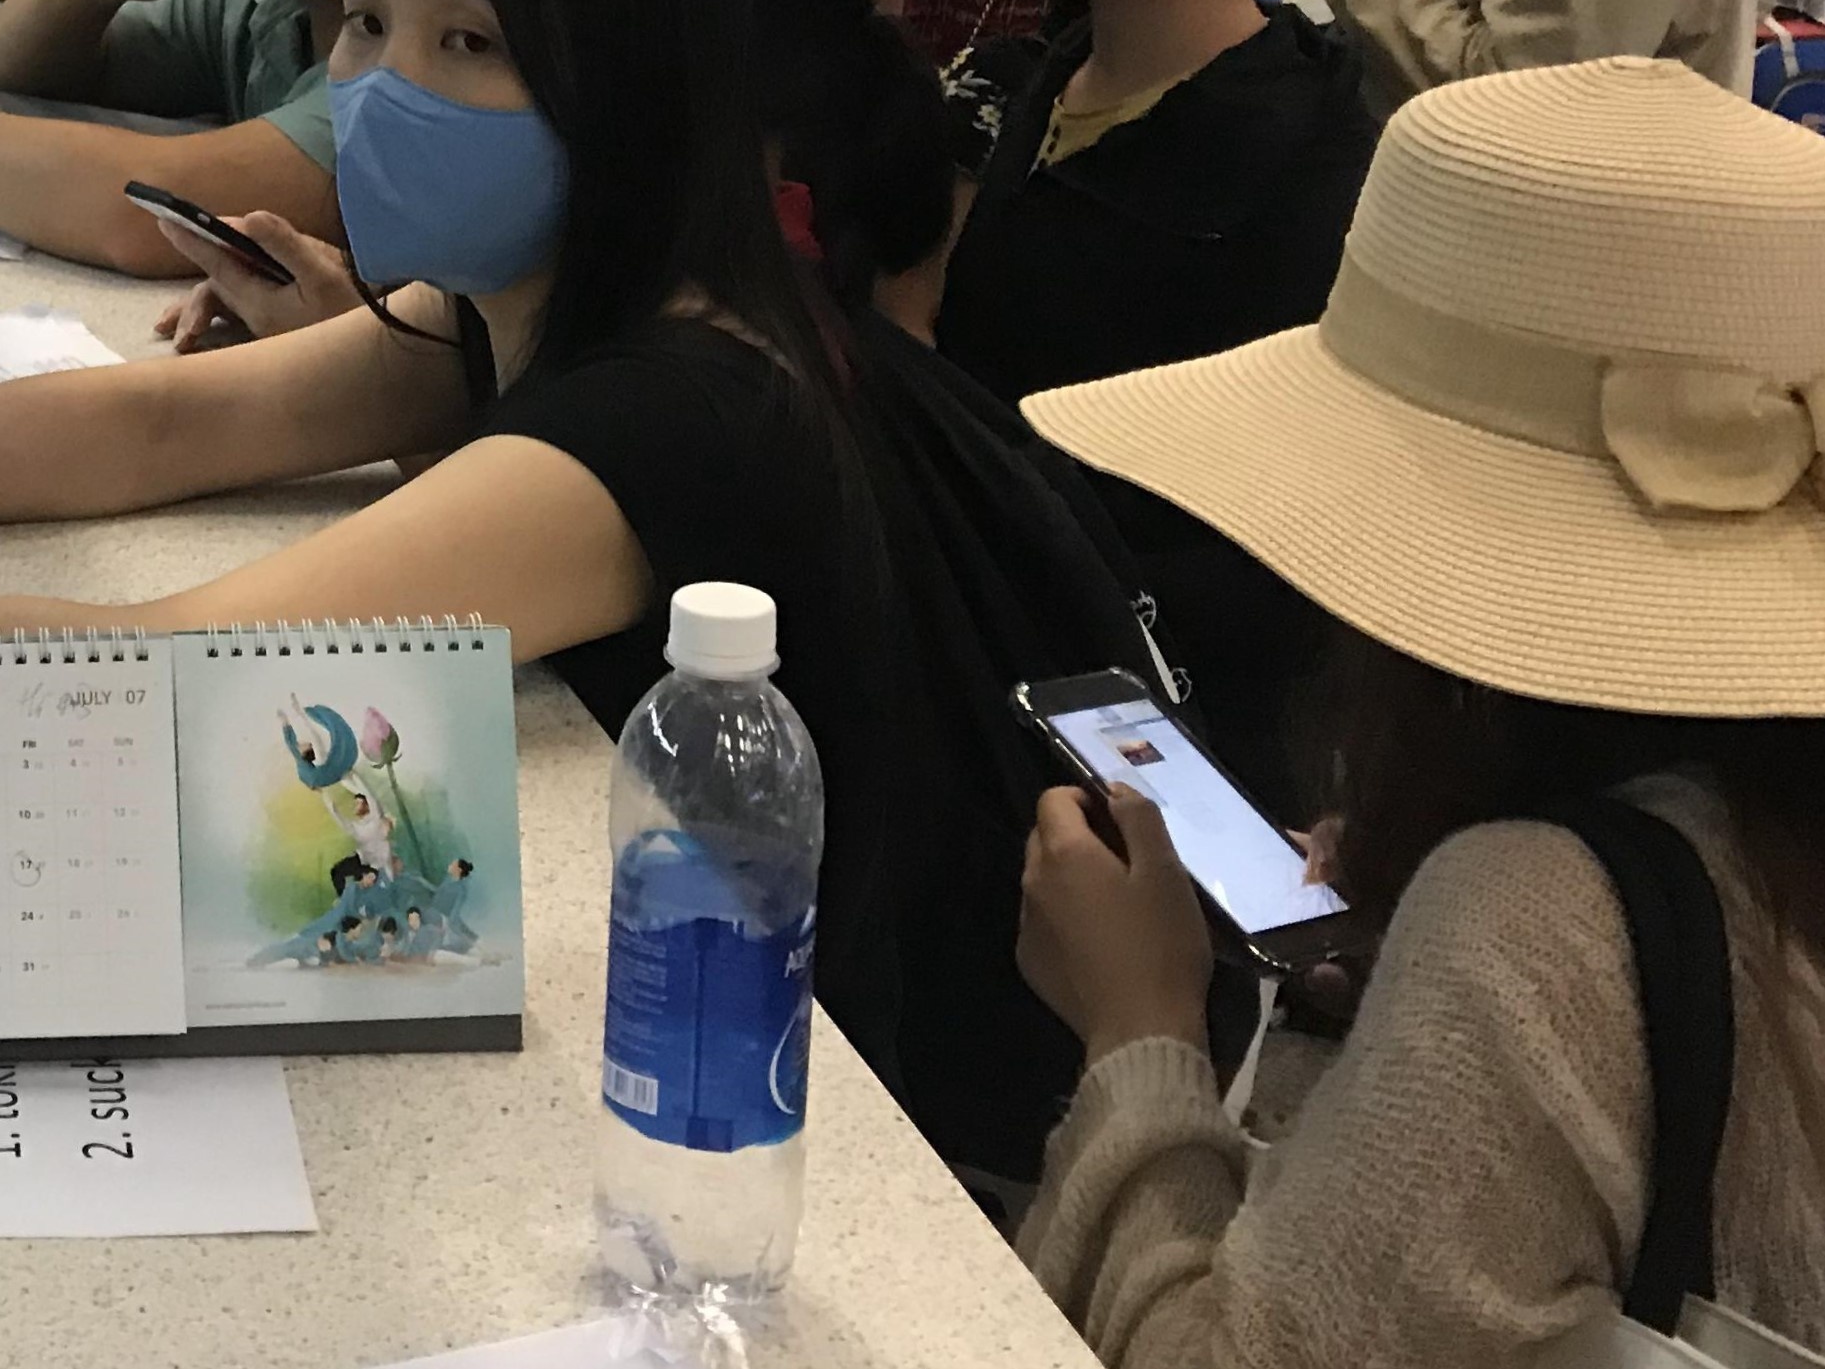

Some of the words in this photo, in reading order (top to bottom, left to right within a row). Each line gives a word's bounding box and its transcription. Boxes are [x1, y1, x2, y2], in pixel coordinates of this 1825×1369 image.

[71, 691, 112, 706] JULY
[125, 690, 147, 705] 07
[22, 739, 37, 748] FRI
[82, 1132, 134, 1160] 2.
